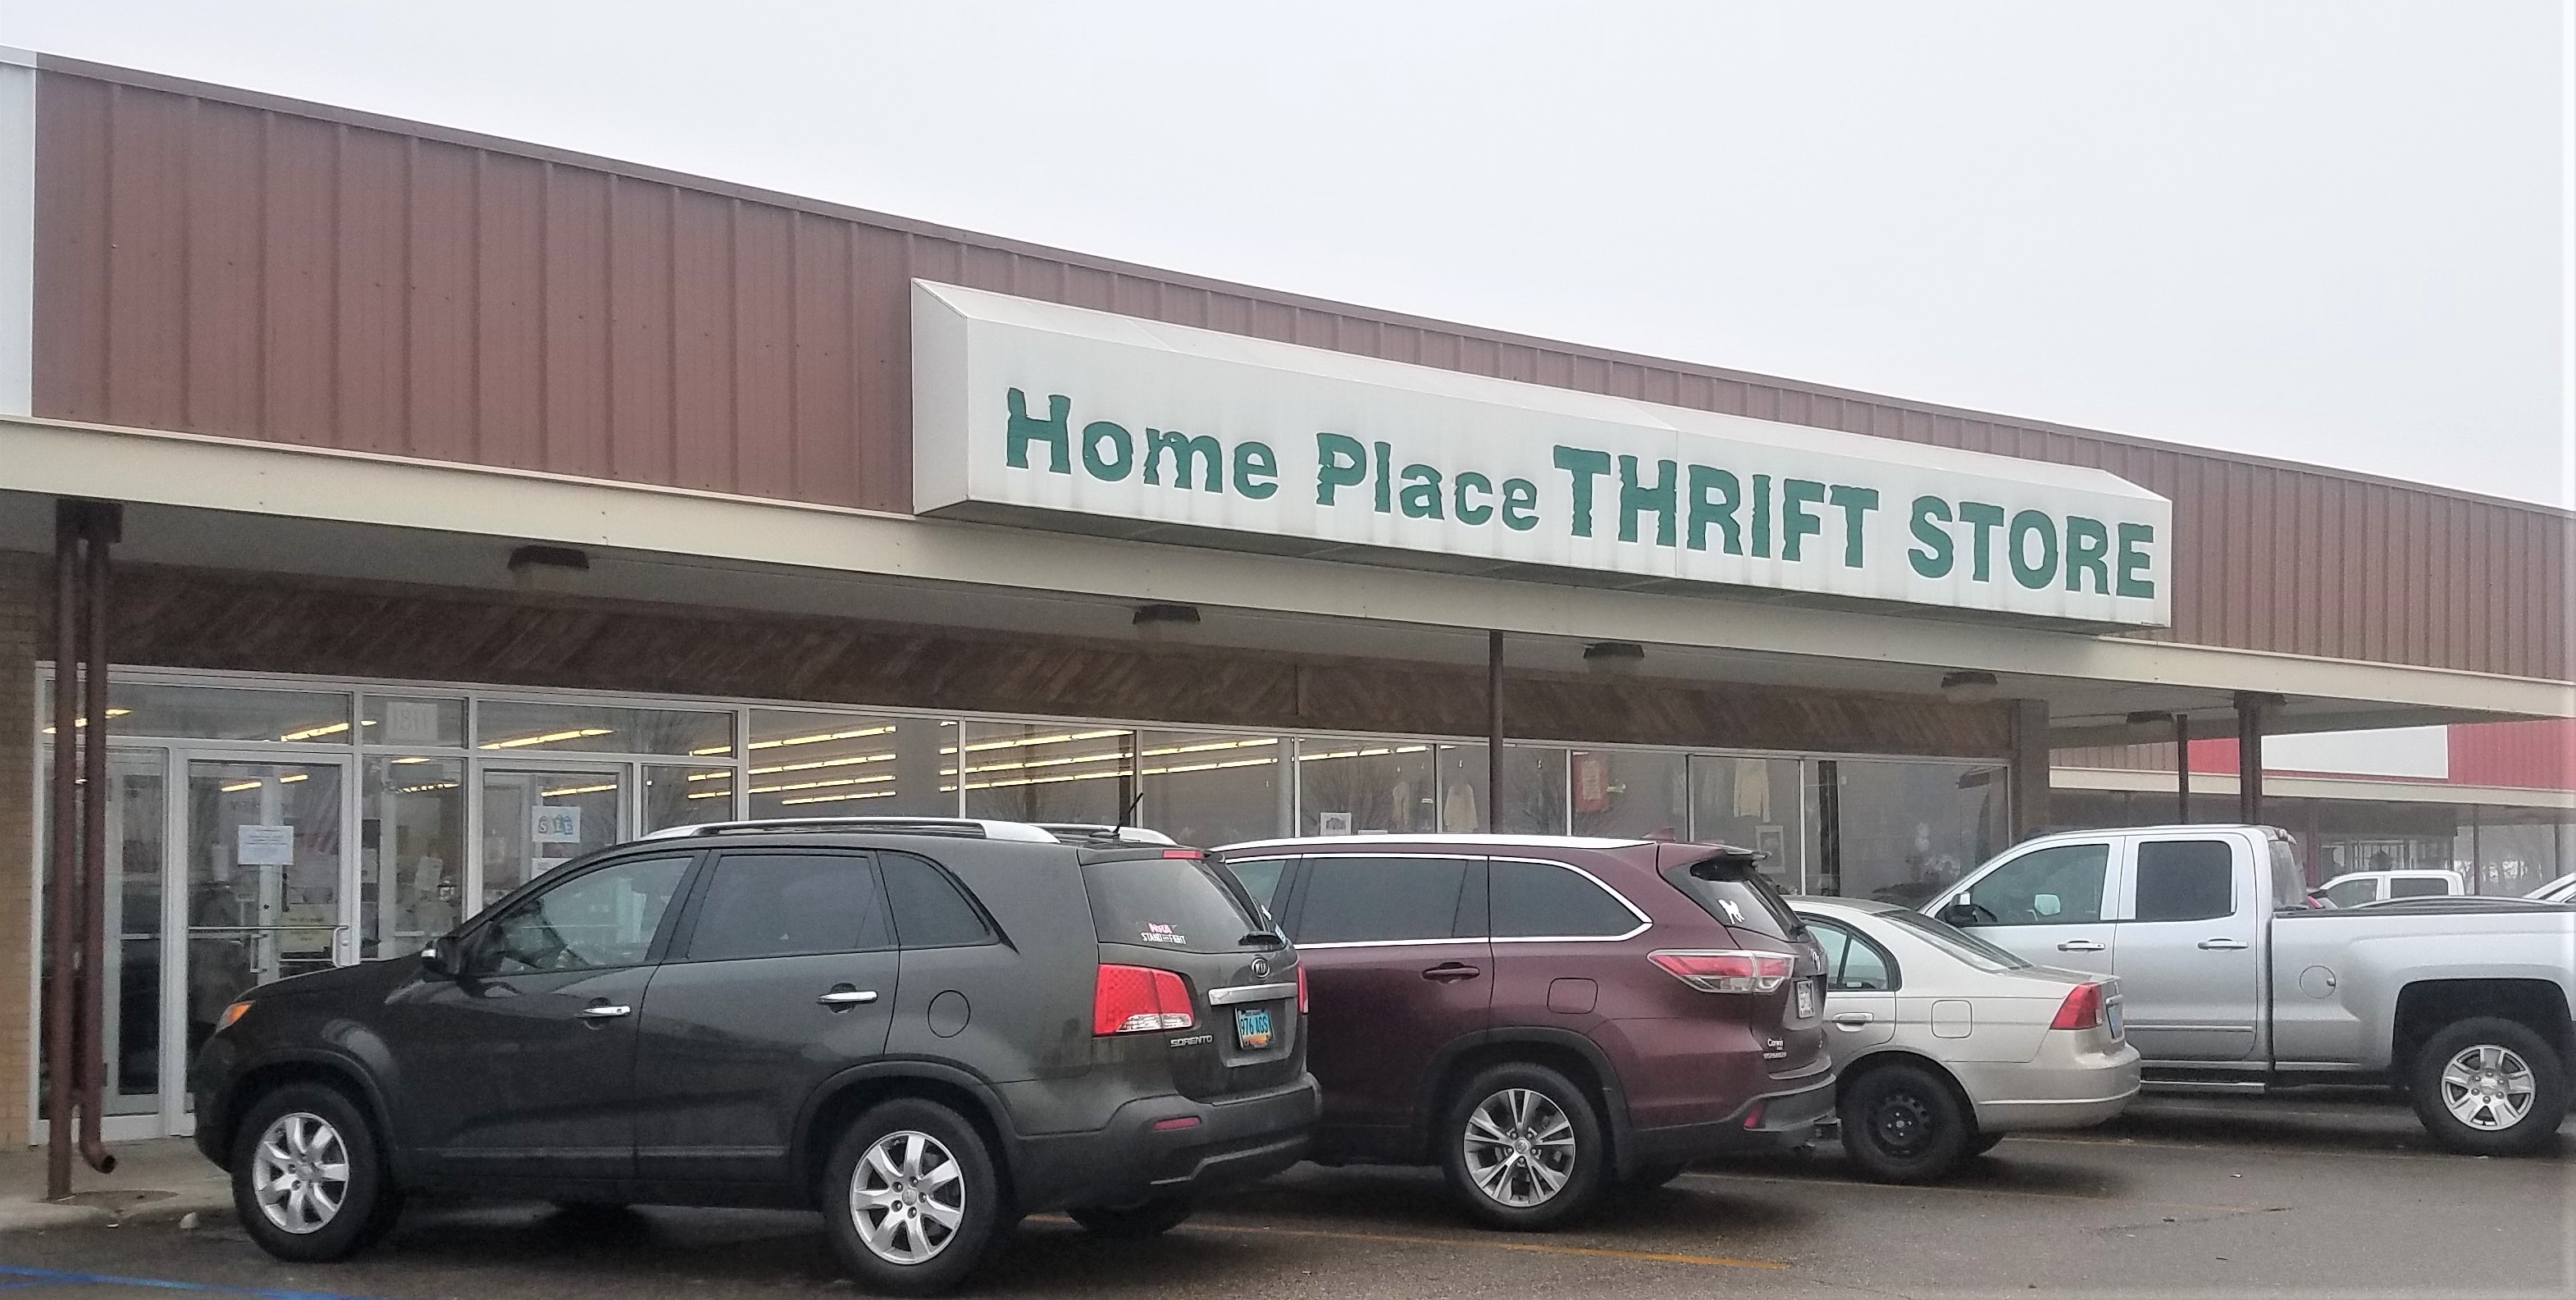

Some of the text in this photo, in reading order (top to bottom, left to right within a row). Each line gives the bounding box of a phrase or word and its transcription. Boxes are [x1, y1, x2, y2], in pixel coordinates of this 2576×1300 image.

[1006, 387, 2155, 600] Home Place THRIFT STORE
[1240, 1018, 1254, 1035] 976
[1170, 1034, 1213, 1047] SORENTO
